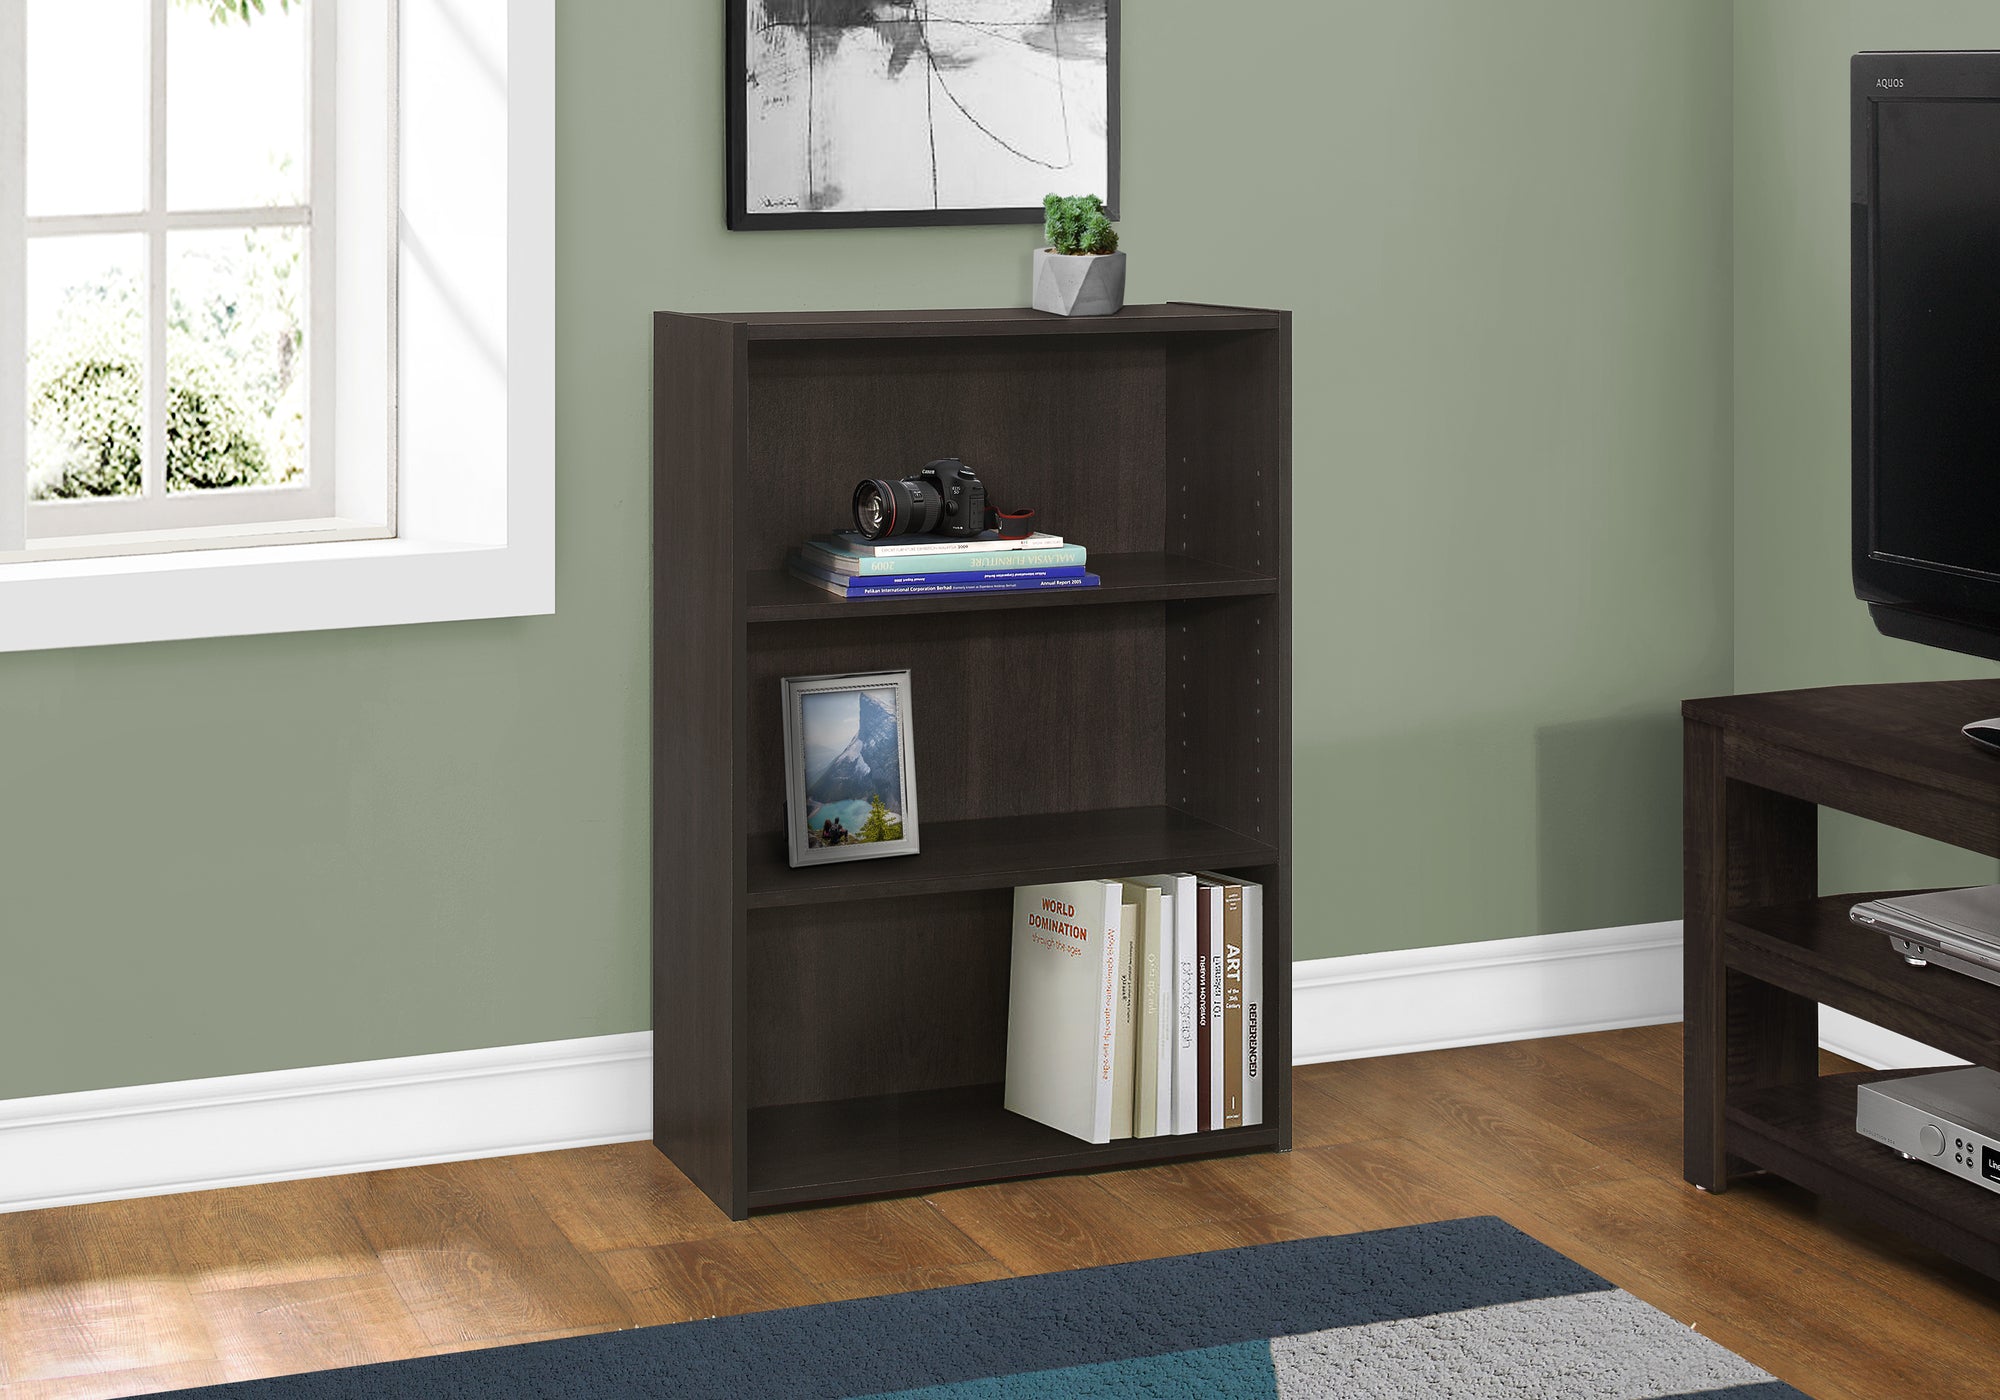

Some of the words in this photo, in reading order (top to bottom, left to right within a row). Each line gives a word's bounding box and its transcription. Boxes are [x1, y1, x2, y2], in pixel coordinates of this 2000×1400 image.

[1875, 78, 1904, 89] AQUOS
[871, 560, 895, 571] 2009
[970, 556, 1025, 567] FURNITURE
[1028, 553, 1076, 566] MALAYSIA
[909, 585, 936, 593] Corporation
[1041, 898, 1075, 918] WORLD
[1028, 913, 1087, 941] DOMINATION
[1226, 943, 1241, 982] ART
[1248, 1002, 1258, 1078] REFERENCED
